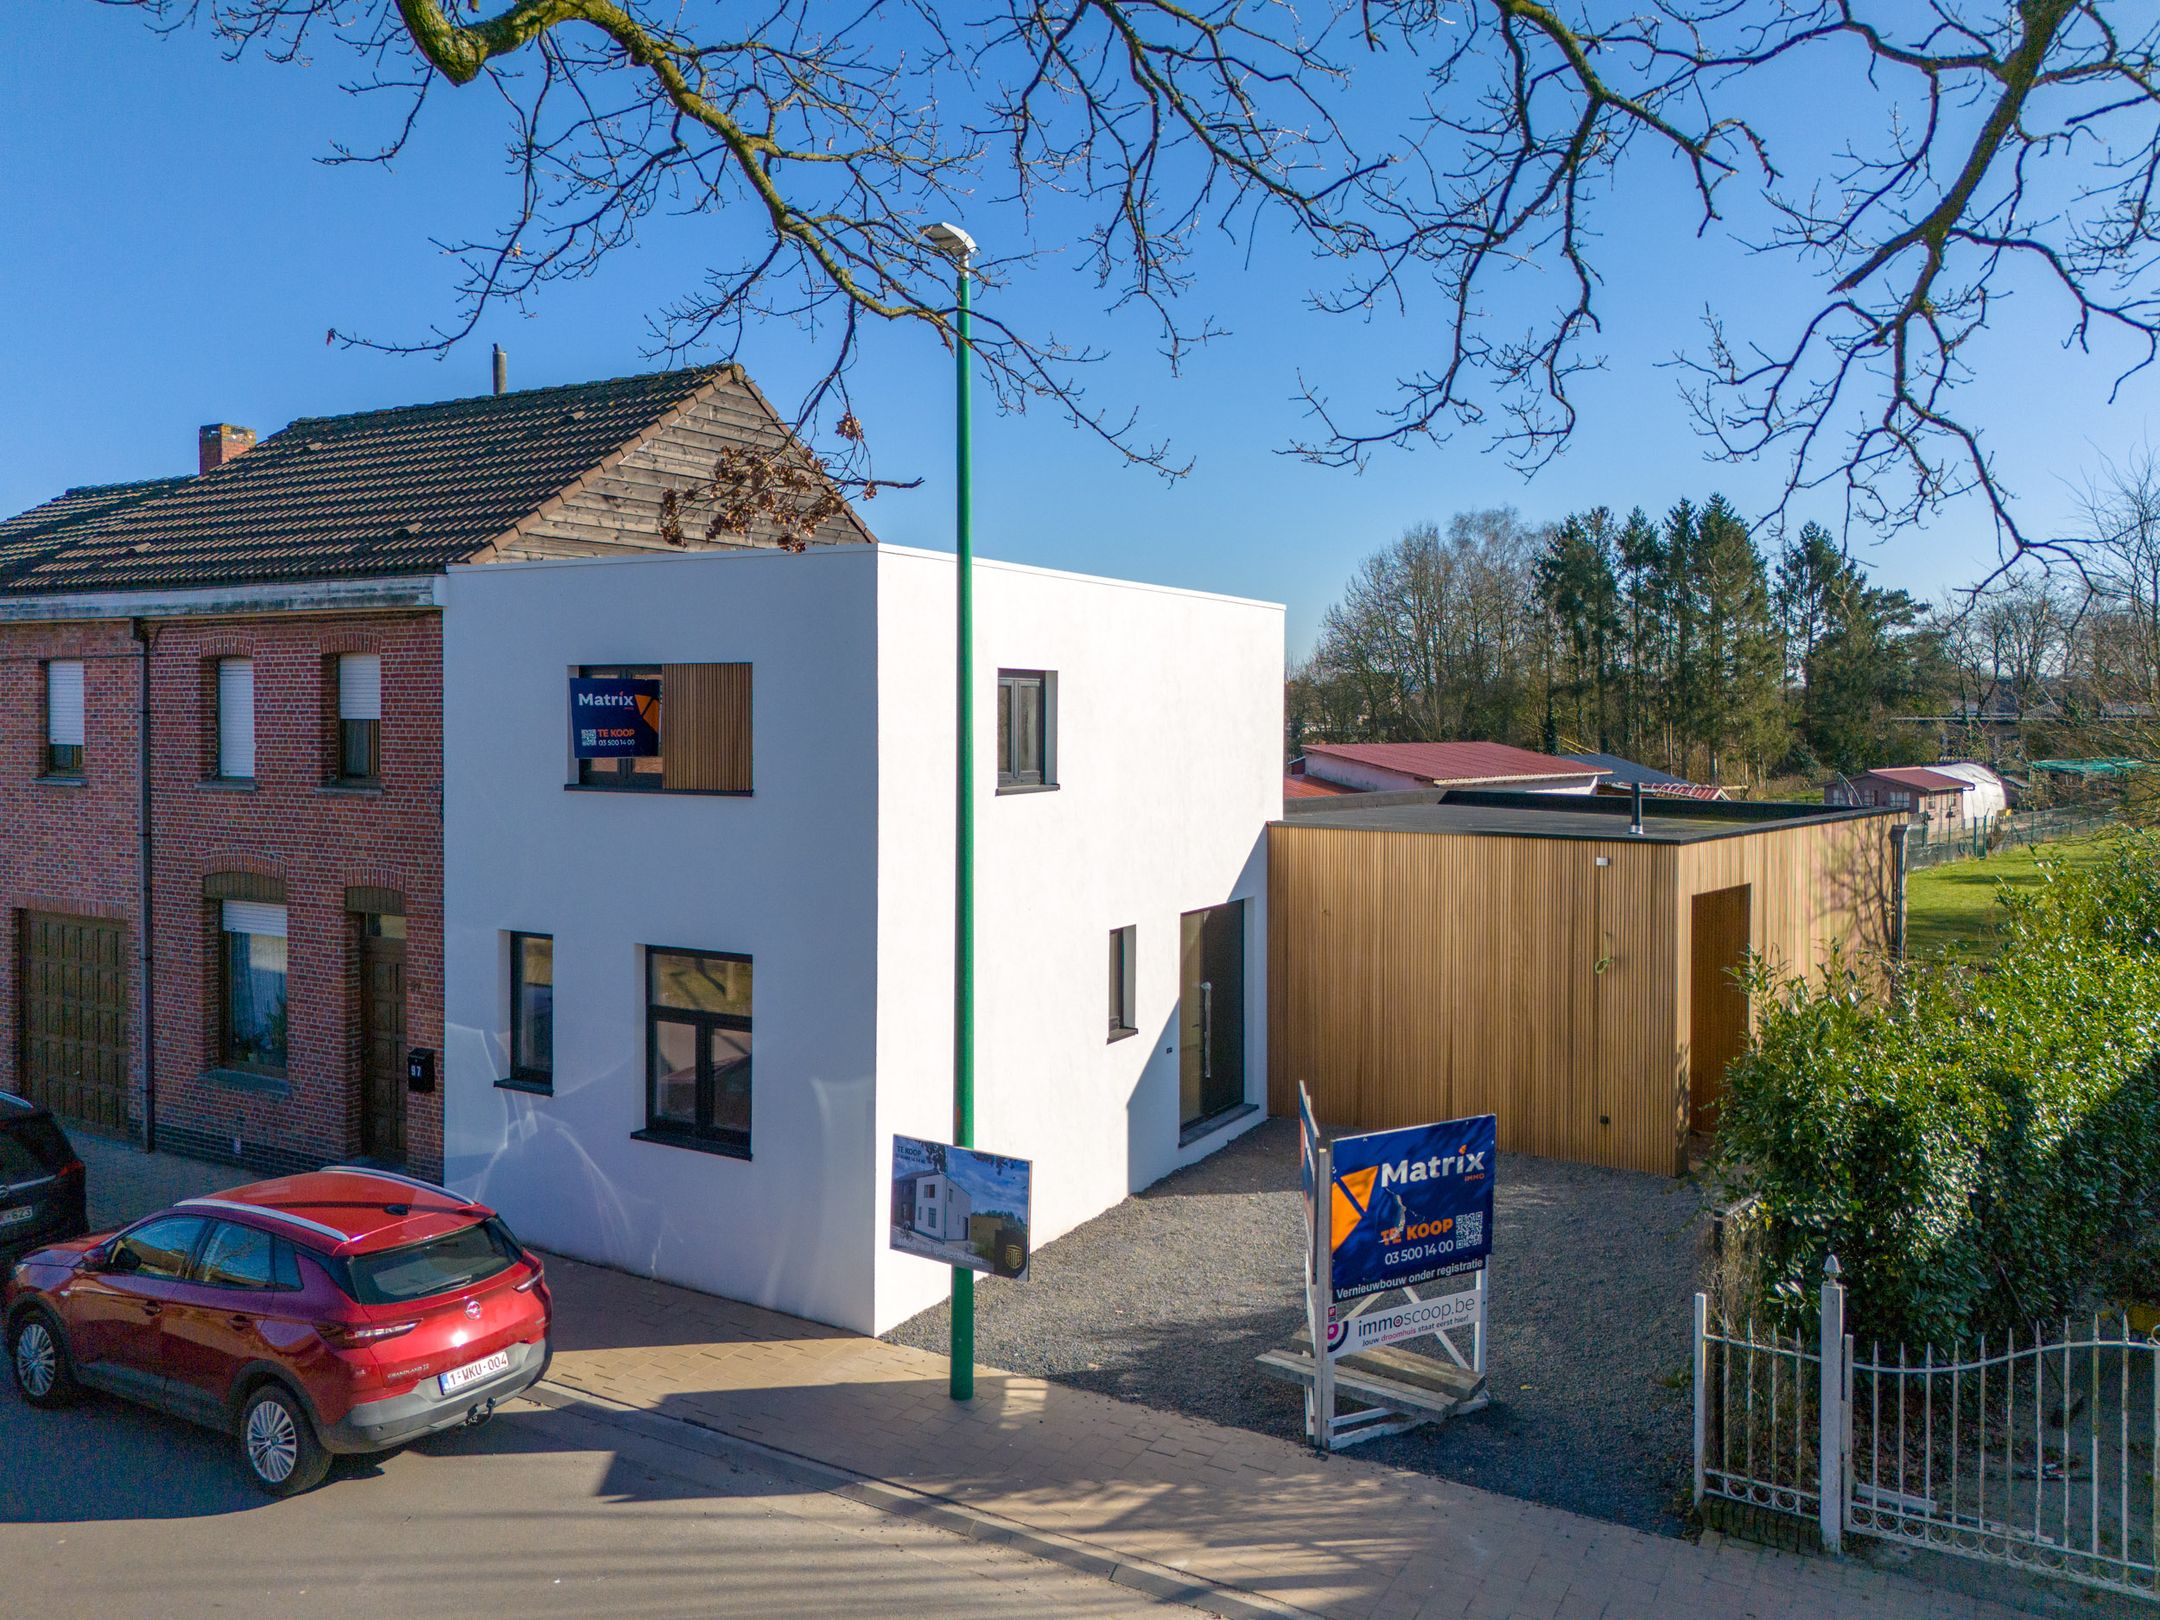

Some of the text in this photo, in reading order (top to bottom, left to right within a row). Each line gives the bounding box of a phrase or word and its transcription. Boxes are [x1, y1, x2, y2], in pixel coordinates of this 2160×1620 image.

[578, 691, 634, 706] Matrix
[598, 729, 635, 737] TE KOOP
[1381, 1145, 1485, 1187] Matrix
[1406, 1218, 1454, 1241] KOOP
[1384, 1239, 1454, 1265] 03 500 14 00
[1336, 1257, 1484, 1299] Vernieuwbouw onder registratie
[1358, 1297, 1475, 1337] immoscoop.be
[1380, 1328, 1417, 1343] droomhuis
[1417, 1323, 1436, 1334] staat
[1435, 1319, 1454, 1331] eerst
